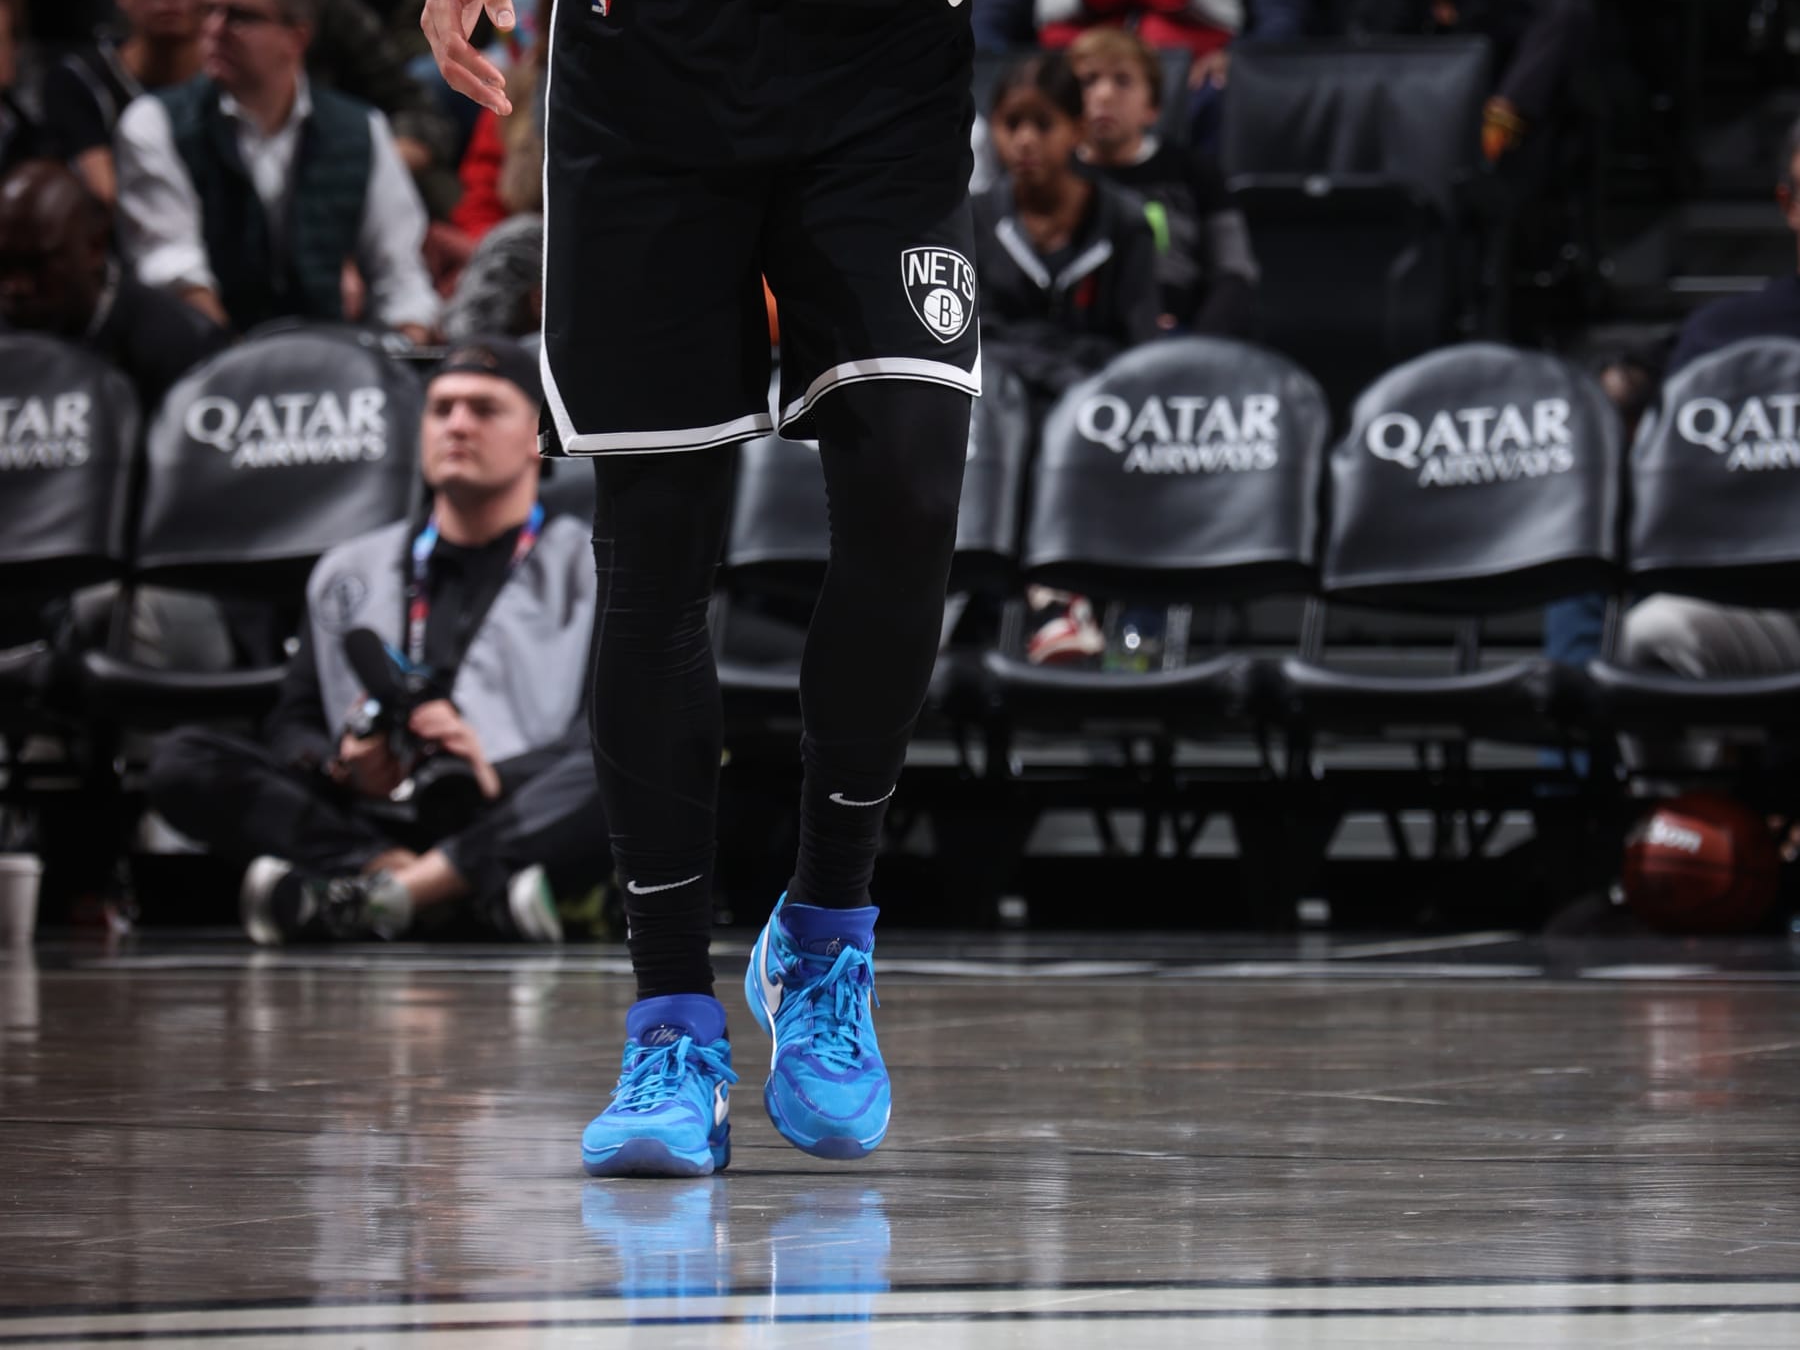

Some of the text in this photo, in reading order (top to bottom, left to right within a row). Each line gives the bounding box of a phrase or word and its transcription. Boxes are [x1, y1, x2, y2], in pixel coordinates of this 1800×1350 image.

[908, 251, 973, 301] NETS
[939, 293, 952, 328] B
[185, 388, 387, 451] QATAR
[1076, 393, 1279, 453] QATAR
[1366, 398, 1572, 469] QATAR
[231, 433, 387, 469] AIRWAYS
[1122, 440, 1279, 474] AIRWAYS
[1418, 443, 1574, 488] AIRWAYS
